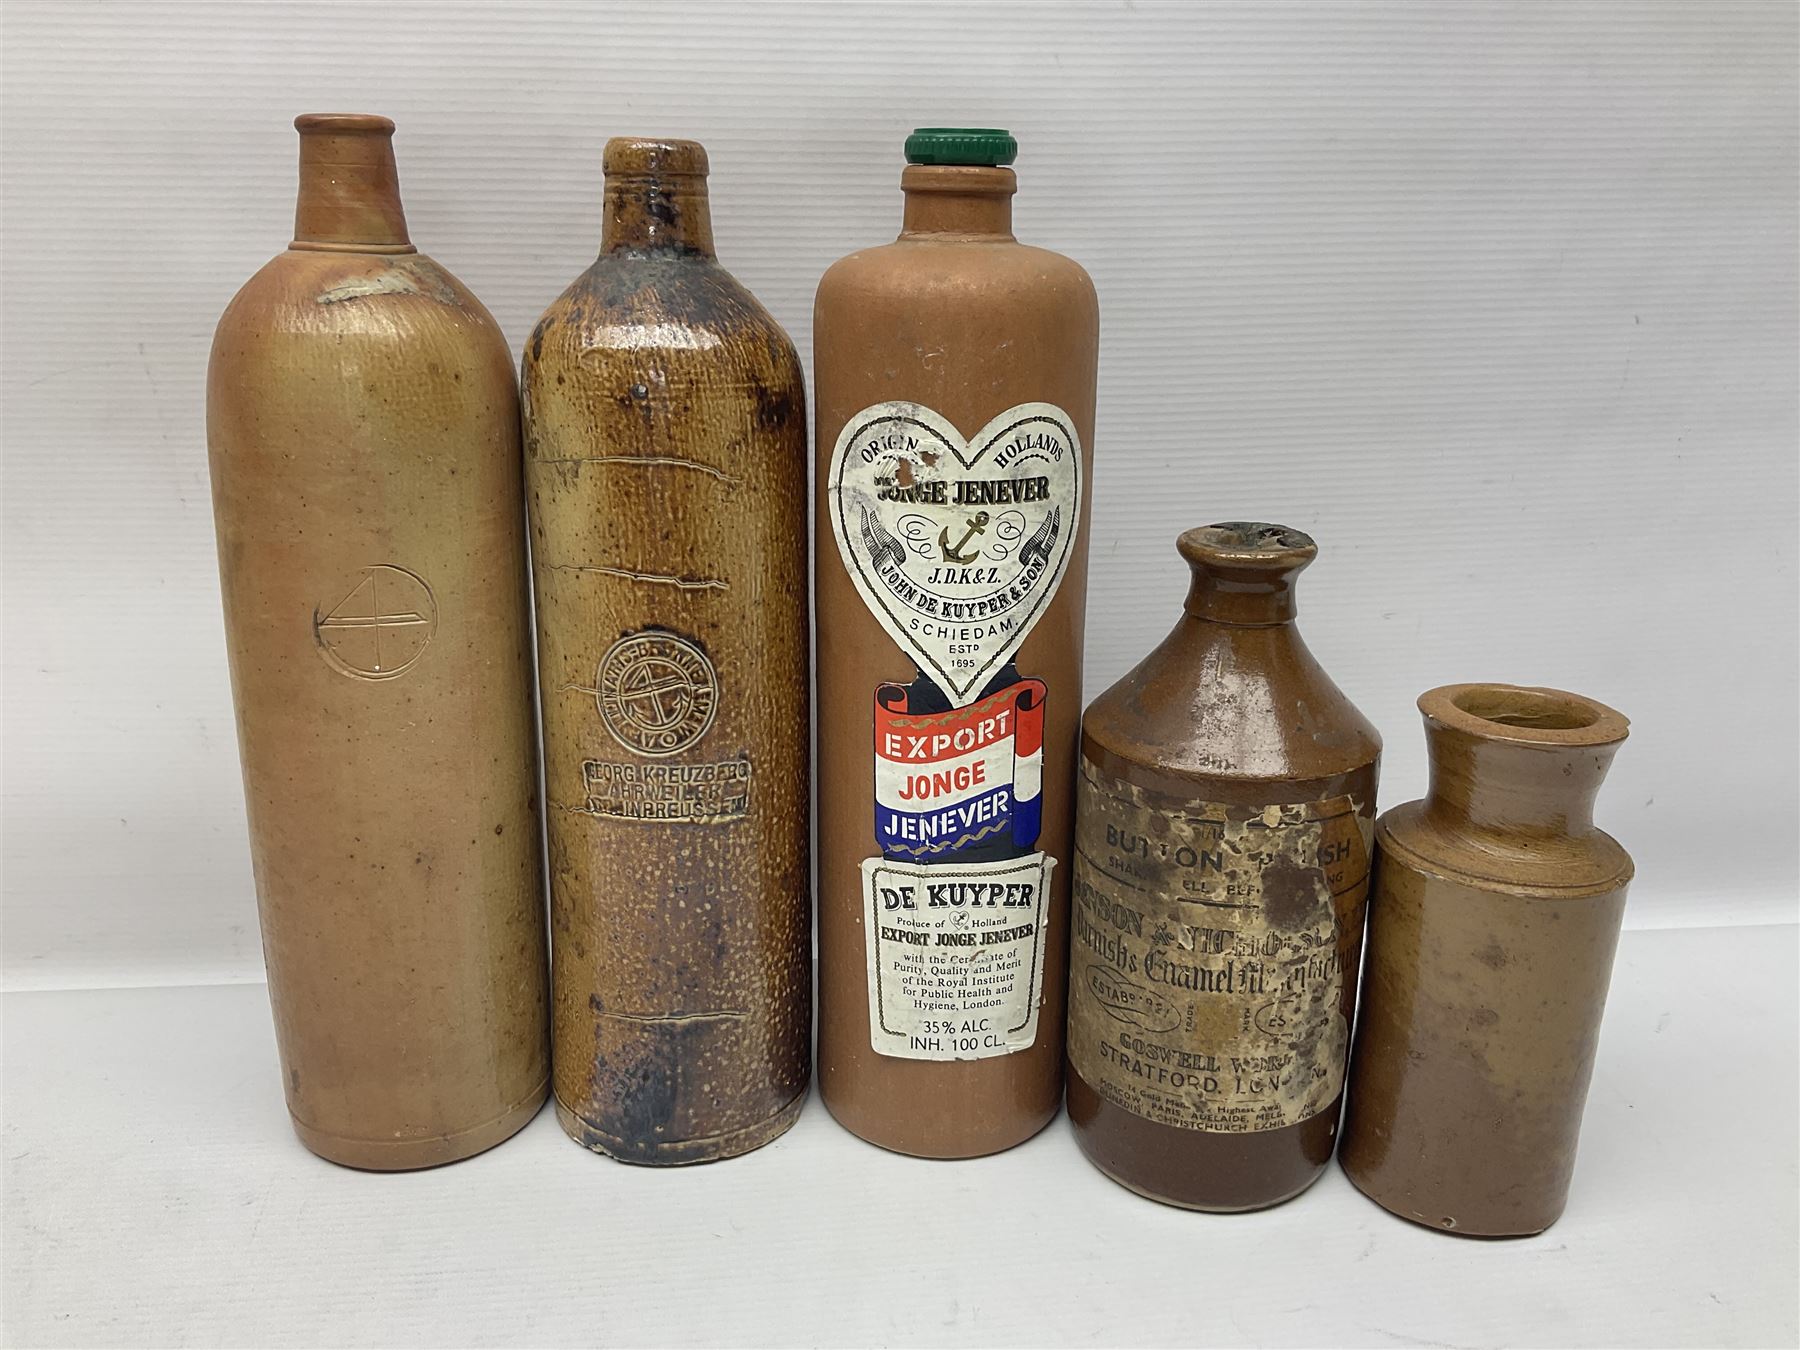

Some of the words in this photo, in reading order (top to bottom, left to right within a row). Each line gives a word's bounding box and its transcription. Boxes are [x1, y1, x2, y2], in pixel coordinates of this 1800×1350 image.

[993, 433, 1063, 469] HOLLANDS
[952, 476, 1051, 505] JENEVER
[881, 565, 918, 603] JOHN
[916, 592, 938, 614] DE
[941, 593, 1012, 619] KUYPER
[1010, 587, 1023, 602] &
[1019, 557, 1046, 592] SON
[910, 618, 1019, 641] SCHIEDAM.
[951, 659, 976, 668] 1695
[885, 709, 1011, 759] EXPORT
[642, 761, 750, 784] KREUZBERG
[898, 759, 986, 801] JONGE
[608, 784, 723, 800] AHRWEILER
[884, 790, 1009, 841] JENEVER
[1107, 823, 1223, 873] BUTTON
[880, 886, 917, 911] DE
[926, 883, 1036, 909] KUYPER
[896, 916, 931, 928] Produce
[934, 919, 946, 928] of
[971, 917, 1008, 928] Holland
[881, 926, 930, 947] EXPORT
[935, 933, 976, 947] JONGE
[979, 923, 1034, 946] JENEVER
[893, 962, 927, 977] Purity,
[930, 964, 969, 977] Quality
[973, 963, 992, 974] and
[996, 959, 1022, 971] Merit
[903, 954, 925, 963] with
[929, 955, 946, 964] the
[1007, 948, 1018, 958] of
[902, 975, 914, 985] of
[916, 976, 933, 986] the
[937, 977, 968, 989] Royal
[972, 972, 1015, 986] Institute
[902, 986, 917, 997] for
[921, 987, 954, 999] Public
[958, 987, 992, 998] Health
[995, 983, 1014, 995] and
[913, 999, 959, 1012] Hygiene,
[963, 999, 1005, 1010] London.
[1184, 1002, 1195, 1033] TRADE
[923, 1020, 956, 1035] 35%
[960, 1018, 993, 1034] ALC.
[1241, 1007, 1251, 1032] MARK
[910, 1037, 945, 1051] INH.
[952, 1037, 979, 1051] 100
[983, 1035, 1006, 1048] CL.
[1119, 1032, 1221, 1073] GOSWELL
[1100, 1040, 1223, 1095] STRATFORD.
